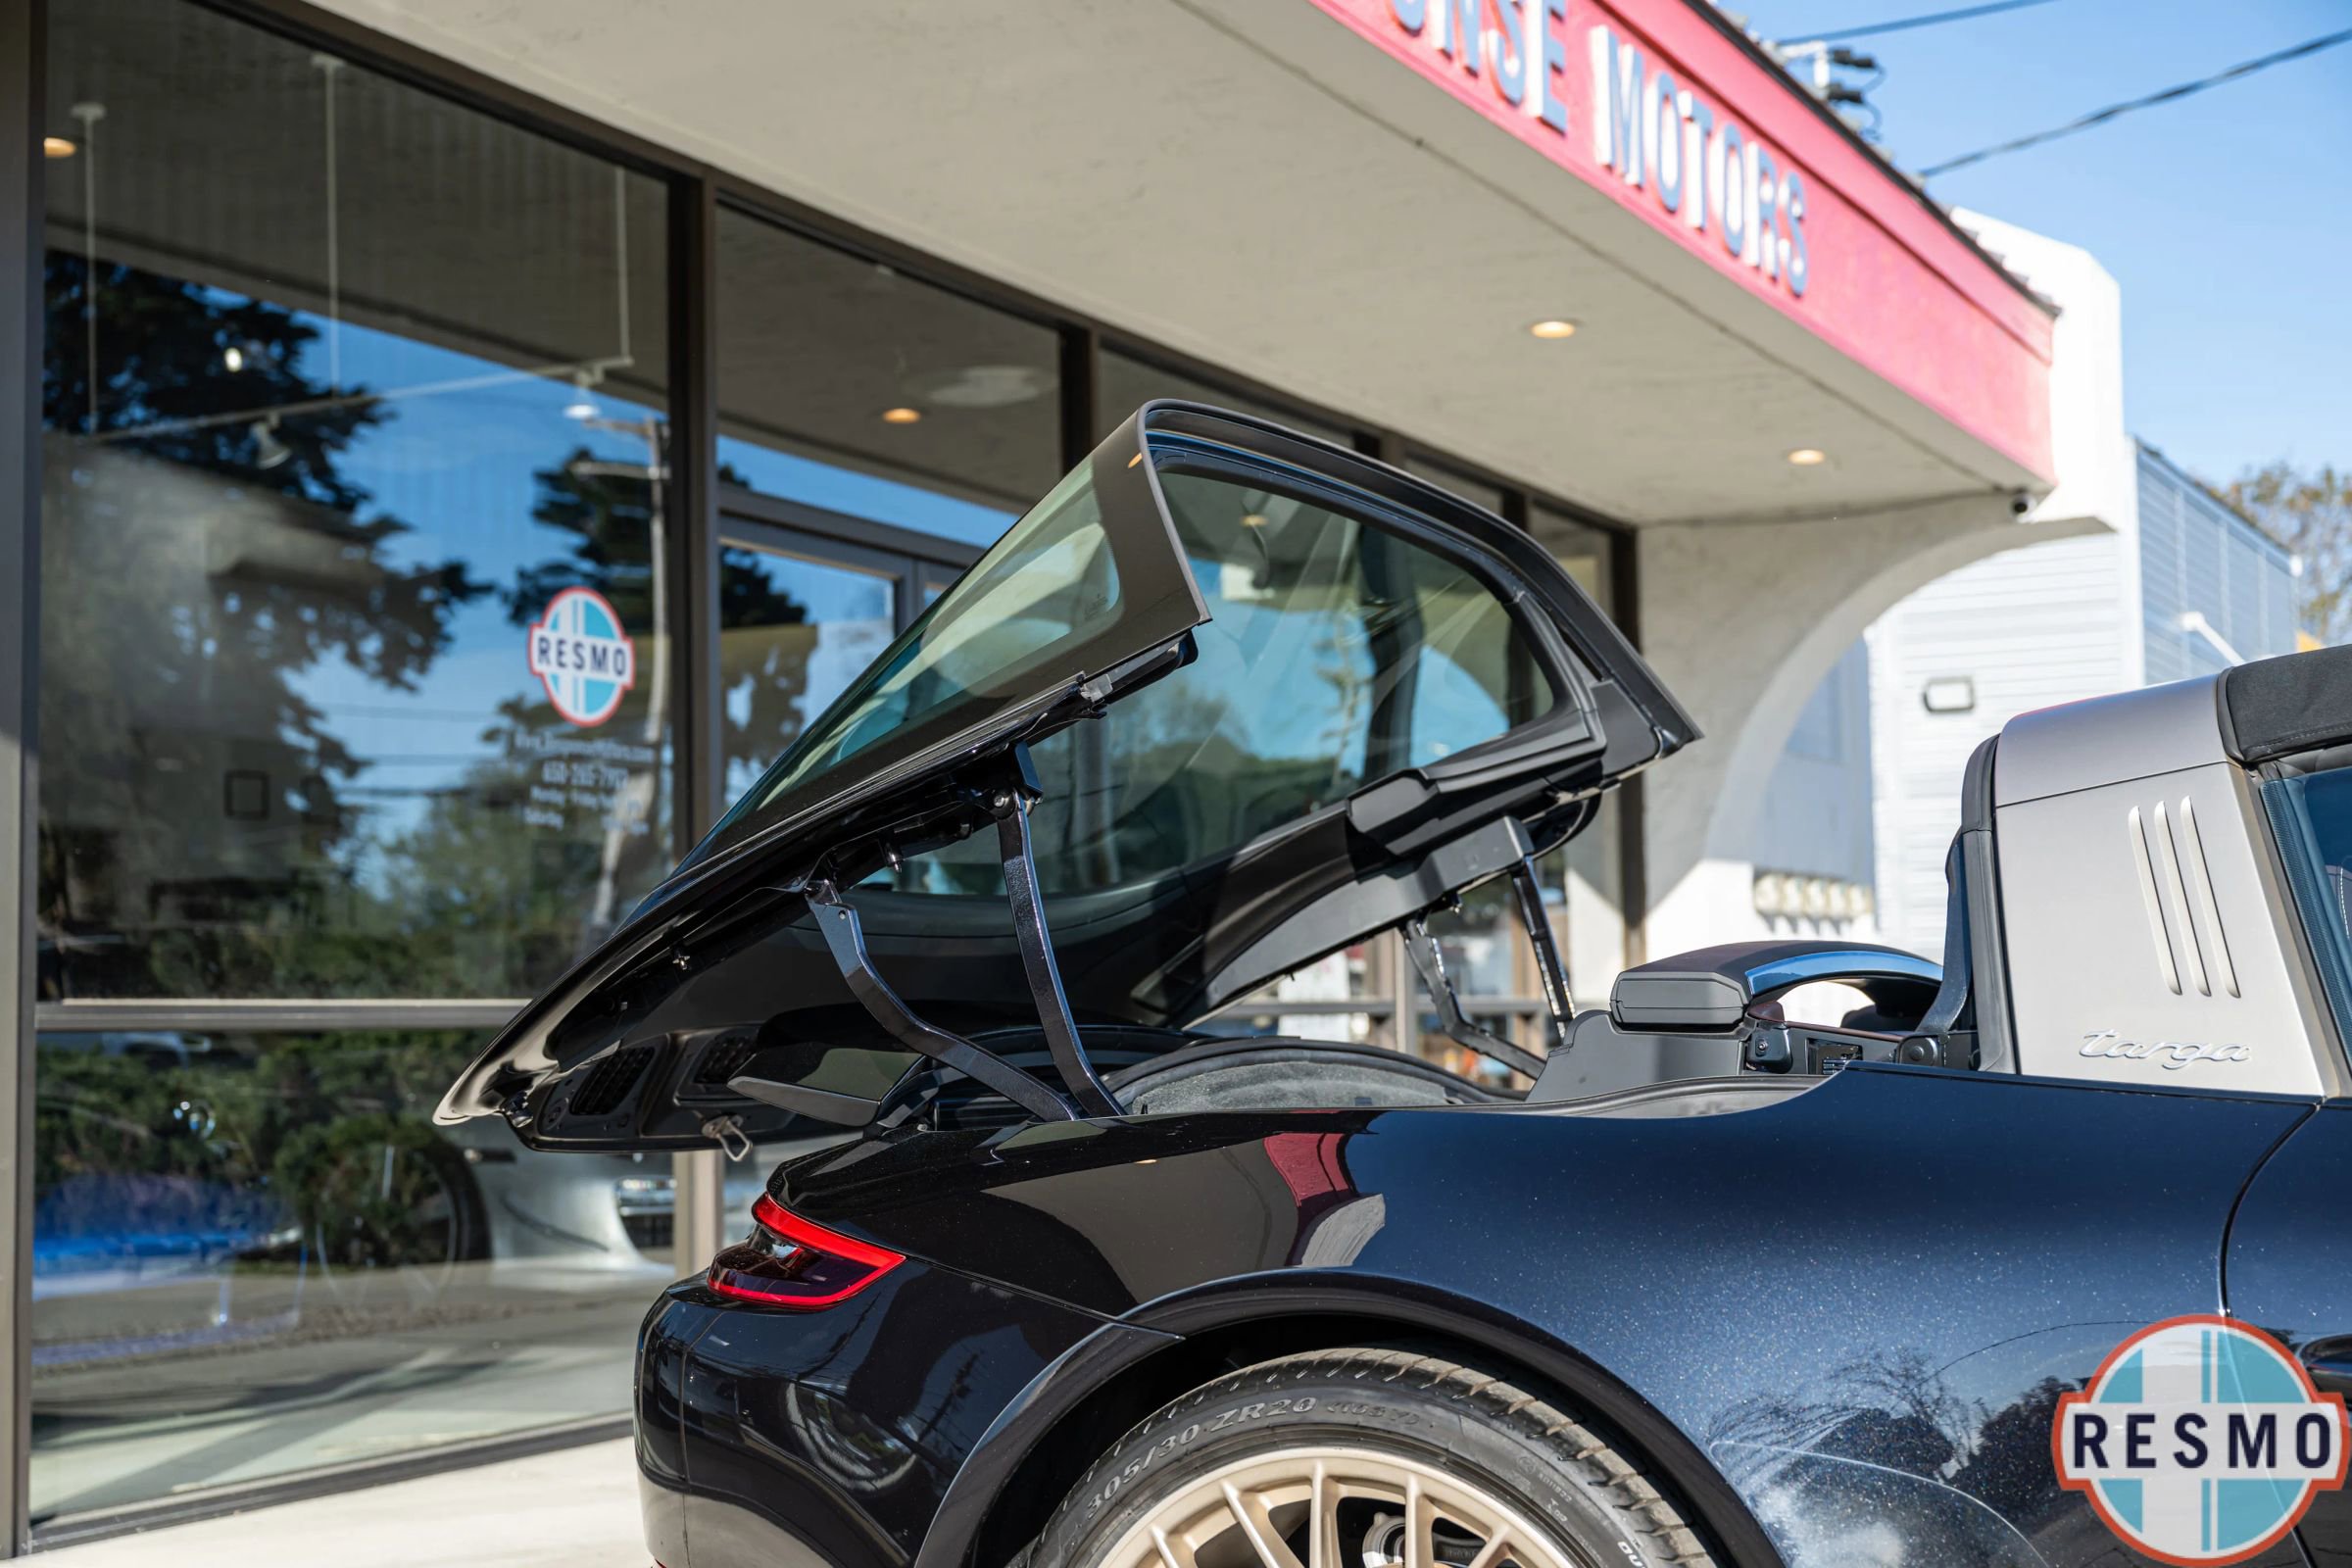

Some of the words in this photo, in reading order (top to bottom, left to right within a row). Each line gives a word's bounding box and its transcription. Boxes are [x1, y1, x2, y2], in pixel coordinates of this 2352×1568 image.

[1590, 24, 1808, 298] MOTORS
[537, 636, 627, 677] RESMO
[2079, 1029, 2252, 1070] targa
[1086, 1423, 1201, 1520] 305/30
[1209, 1396, 1317, 1433] ZR20
